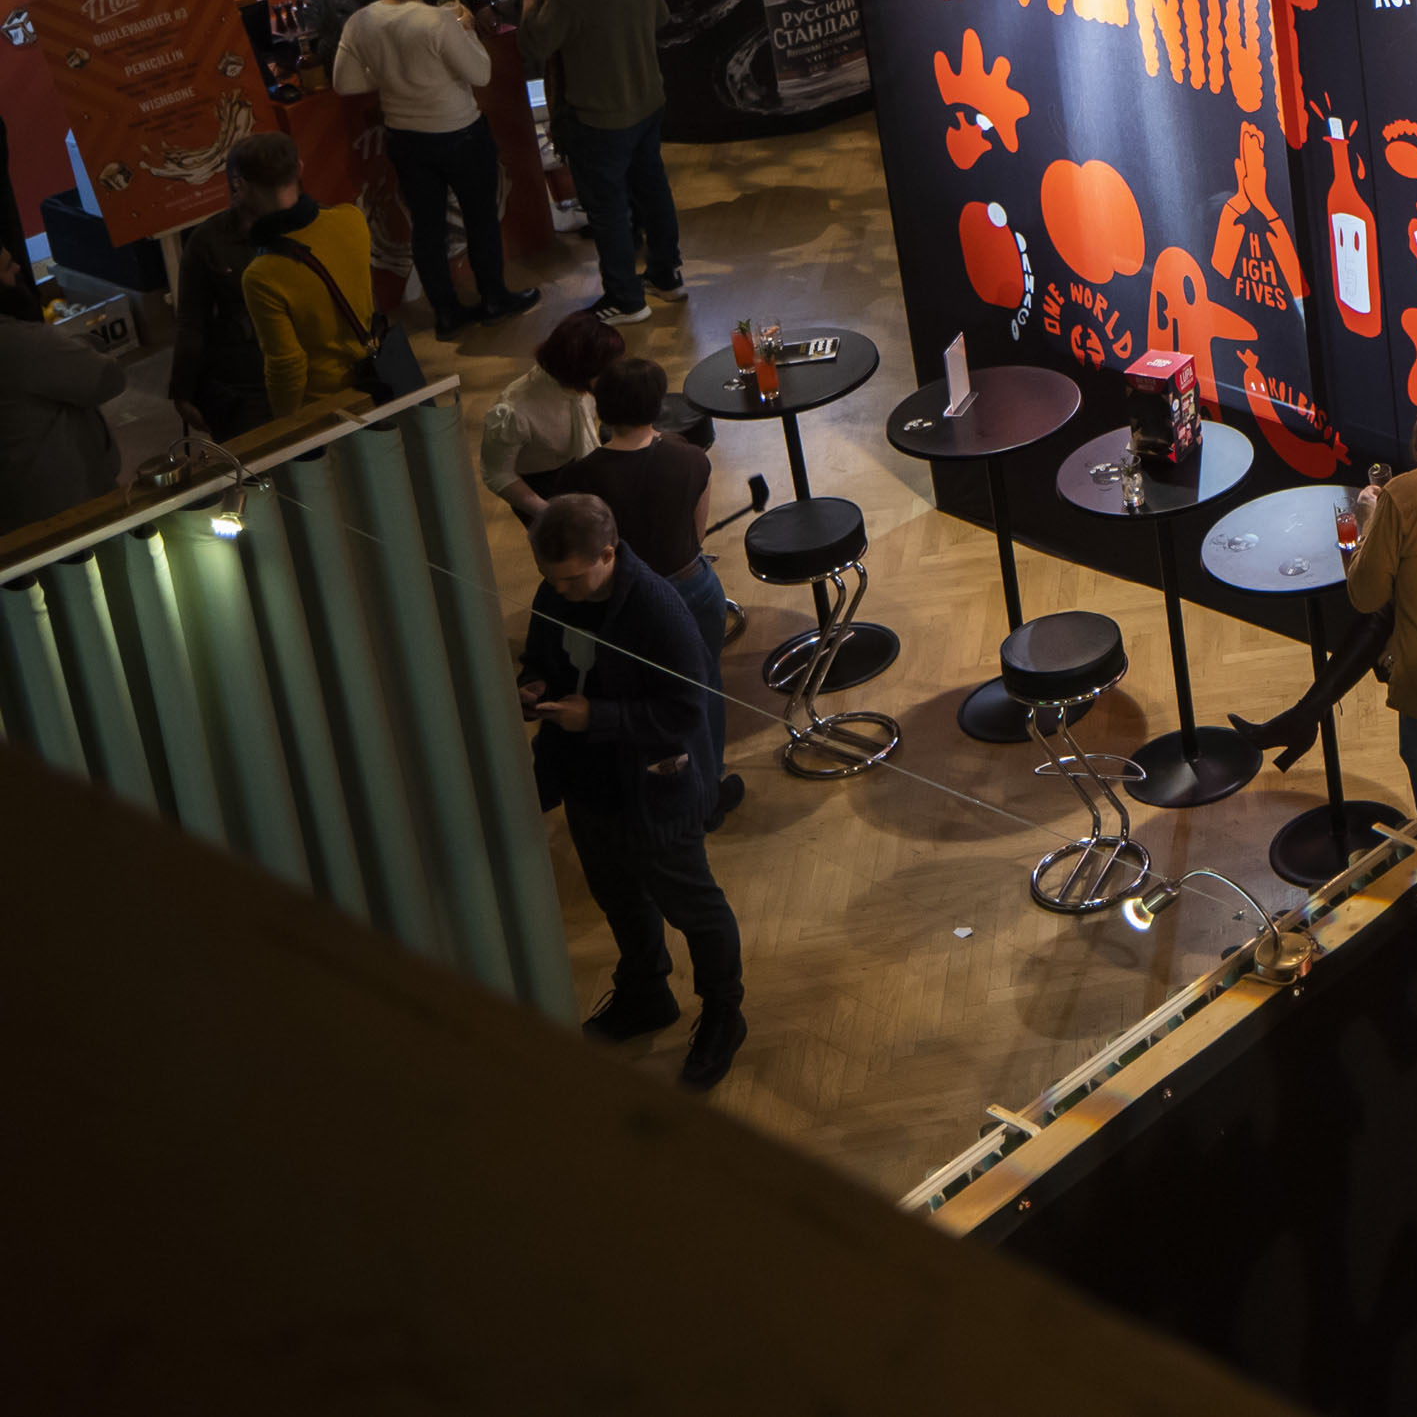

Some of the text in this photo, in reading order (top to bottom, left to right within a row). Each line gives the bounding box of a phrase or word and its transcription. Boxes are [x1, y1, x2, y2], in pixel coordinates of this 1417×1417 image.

[92, 14, 172, 47] BOULEVARDIER
[124, 48, 184, 78] PENICILLIN
[139, 86, 196, 113] WISHBONE
[1234, 277, 1287, 311] FIVES
[1042, 282, 1133, 359] ONE WORLD
[1179, 366, 1194, 384] LUPA
